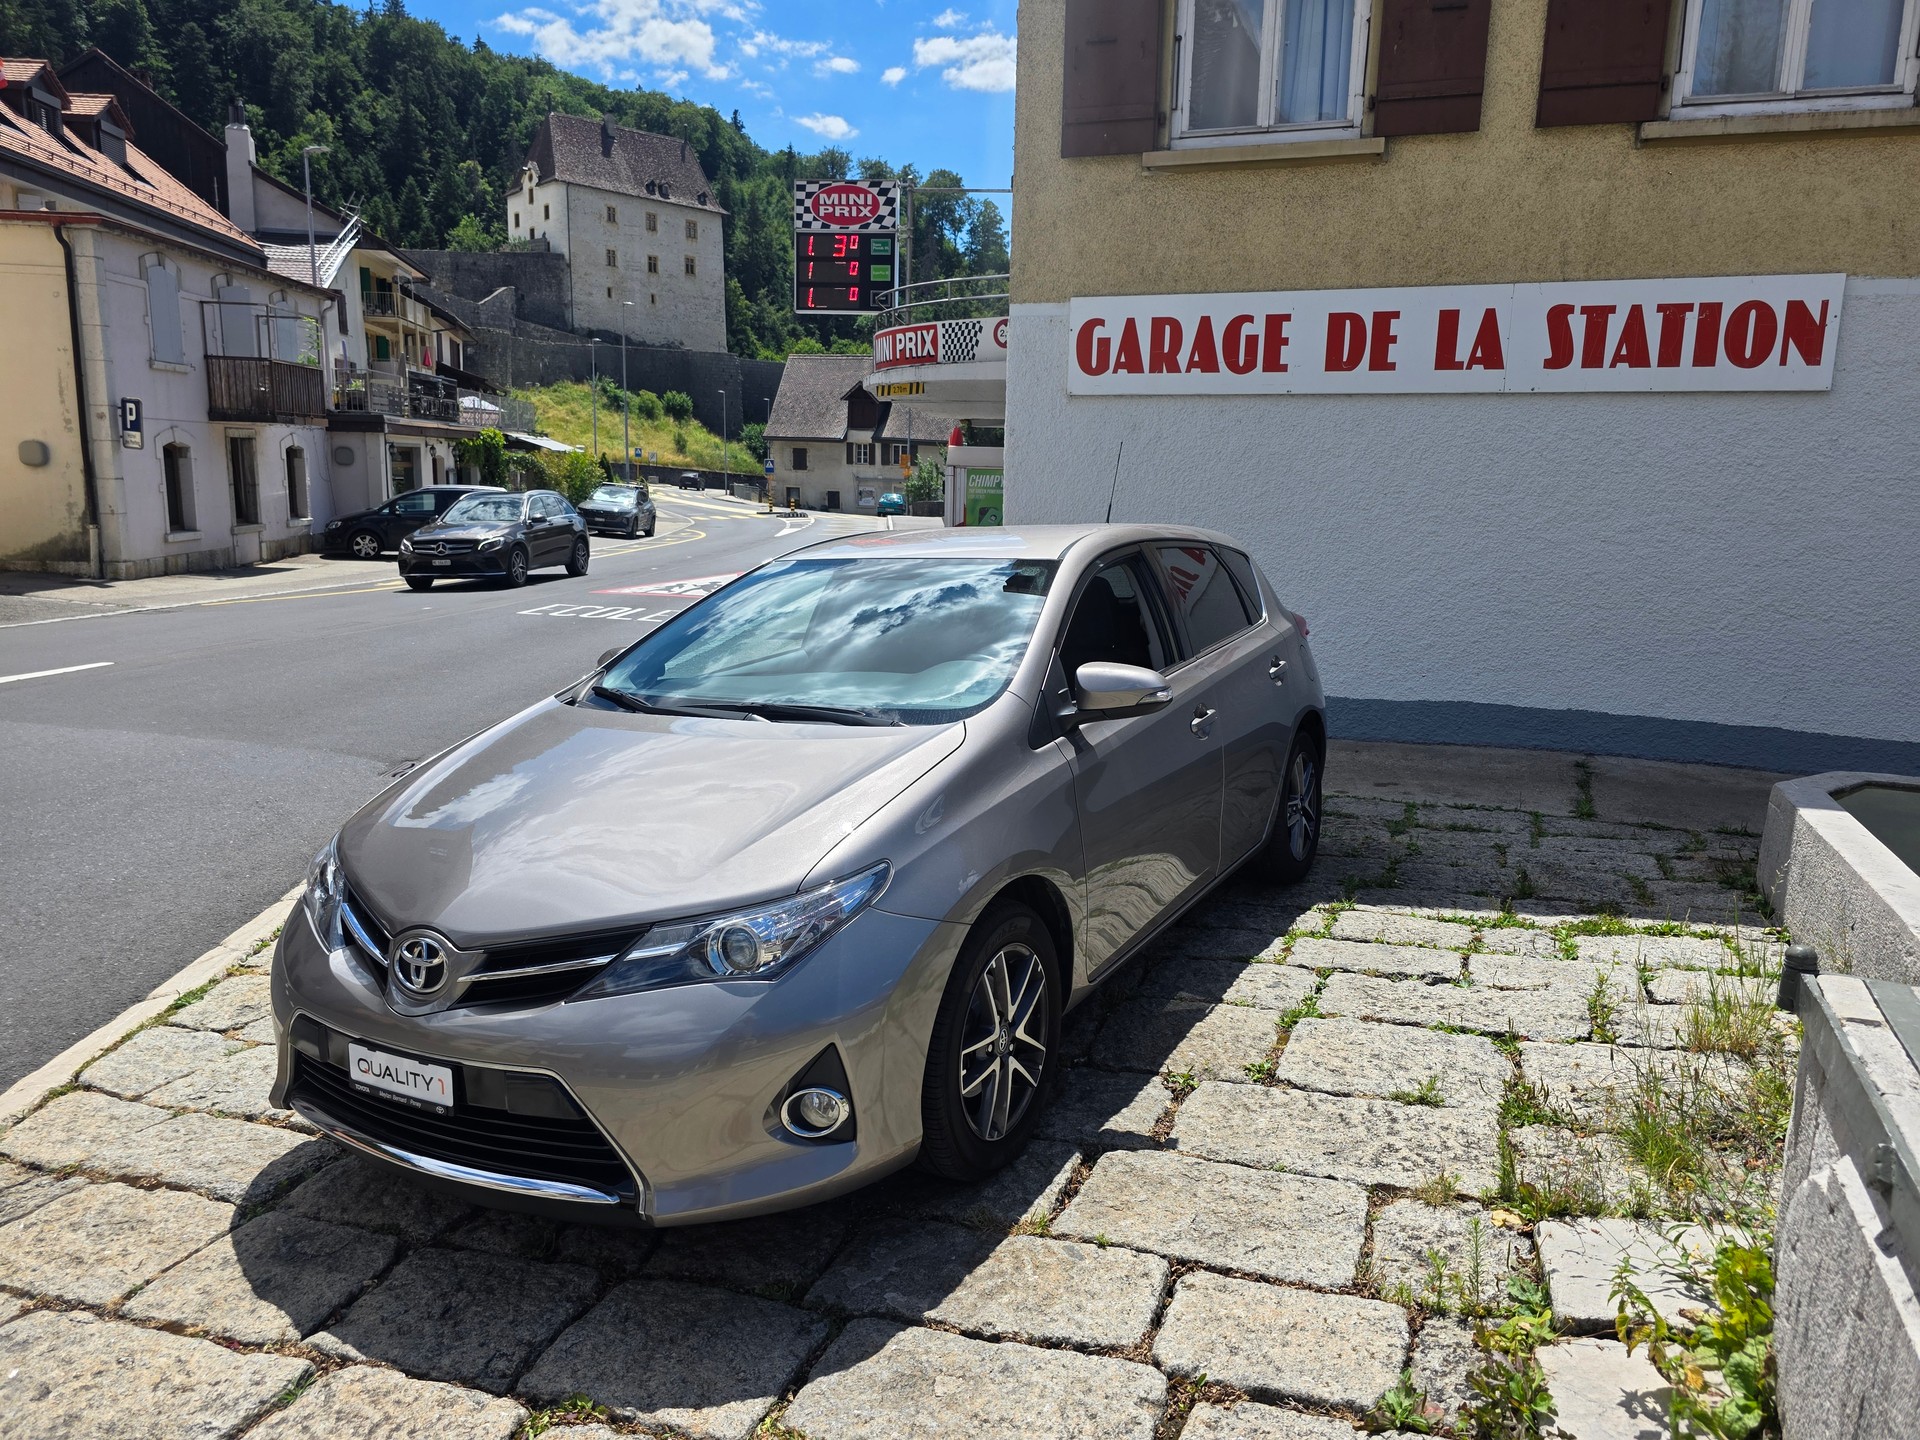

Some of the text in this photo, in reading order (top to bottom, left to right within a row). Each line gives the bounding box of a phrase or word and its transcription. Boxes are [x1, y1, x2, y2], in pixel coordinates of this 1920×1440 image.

[819, 193, 873, 205] MINI
[819, 206, 873, 217] PRIX
[895, 329, 936, 360] PRIX
[1076, 300, 1830, 376] GARAGE DE LA STATION
[126, 402, 136, 429] P
[516, 603, 679, 622] ECOLE
[357, 1057, 445, 1095] QUALITY 1
[354, 1083, 371, 1093] TOYOTA
